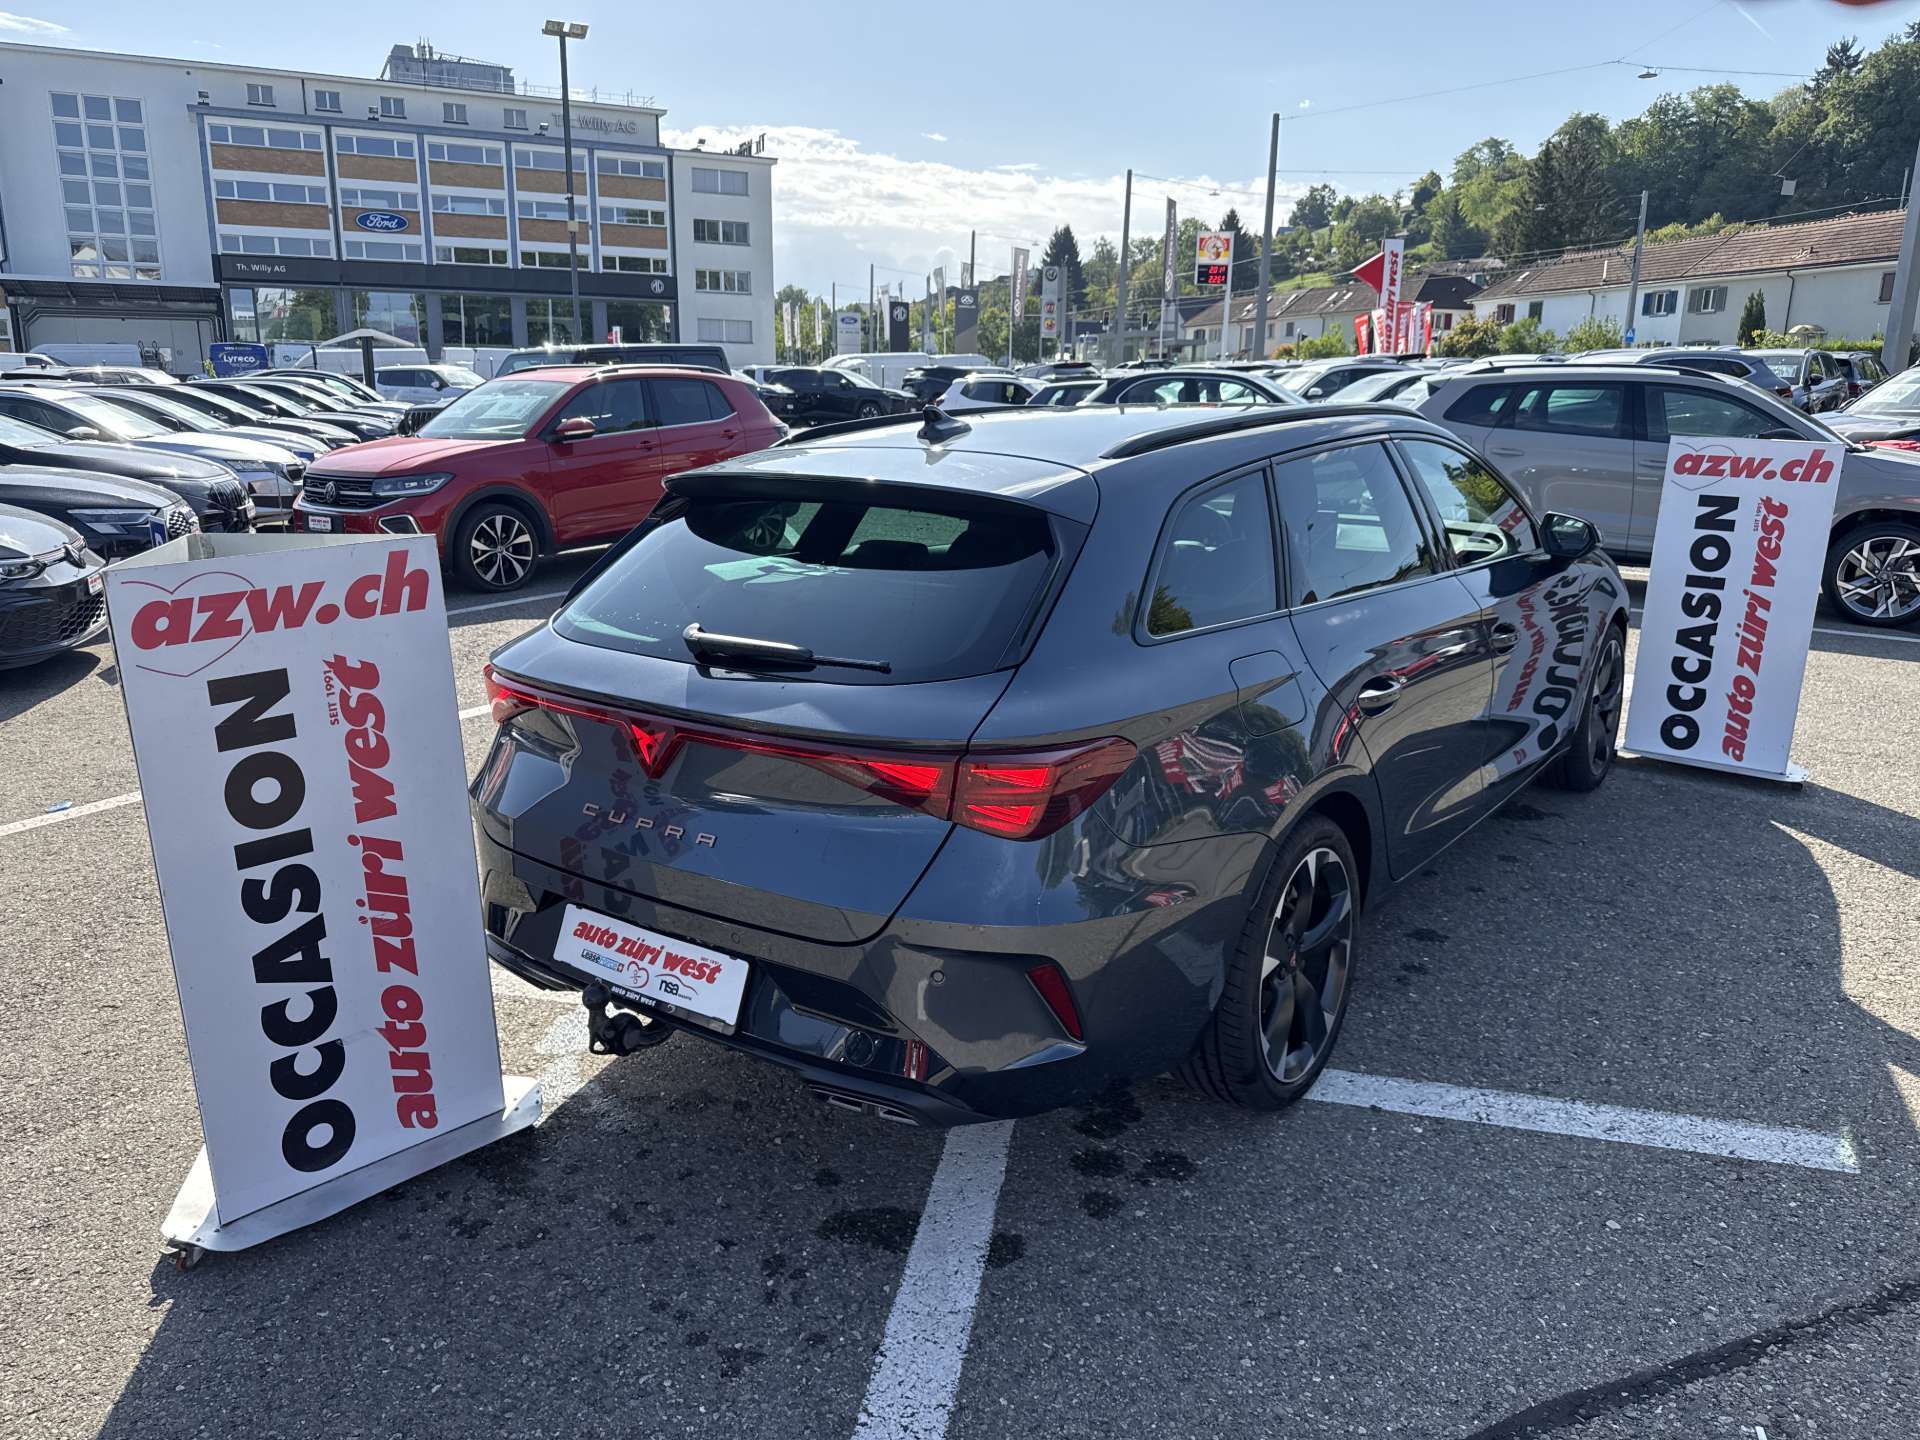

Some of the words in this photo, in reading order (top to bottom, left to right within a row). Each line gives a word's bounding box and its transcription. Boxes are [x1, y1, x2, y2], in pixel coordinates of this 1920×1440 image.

[616, 118, 640, 134] AG
[366, 213, 399, 229] Ford
[235, 263, 249, 271] Th.
[250, 263, 272, 274] Willy
[273, 264, 288, 273] AG
[1388, 249, 1400, 287] west
[1673, 449, 1835, 483] azw.ch
[1751, 495, 1789, 587] west
[131, 550, 429, 650] azw.ch
[1660, 494, 1740, 750] OCCASION
[1735, 588, 1772, 676] züri
[323, 669, 336, 697] 1991
[328, 702, 340, 726] SEIT
[322, 654, 398, 824] west
[1722, 674, 1756, 762] auto
[582, 802, 717, 848] CUPRA
[206, 667, 357, 1173] OCCASION
[347, 834, 419, 977] züri
[573, 921, 619, 949] auto
[615, 936, 666, 966] züri
[662, 951, 723, 985] west
[659, 978, 679, 996] nsa
[375, 984, 439, 1130] auto
